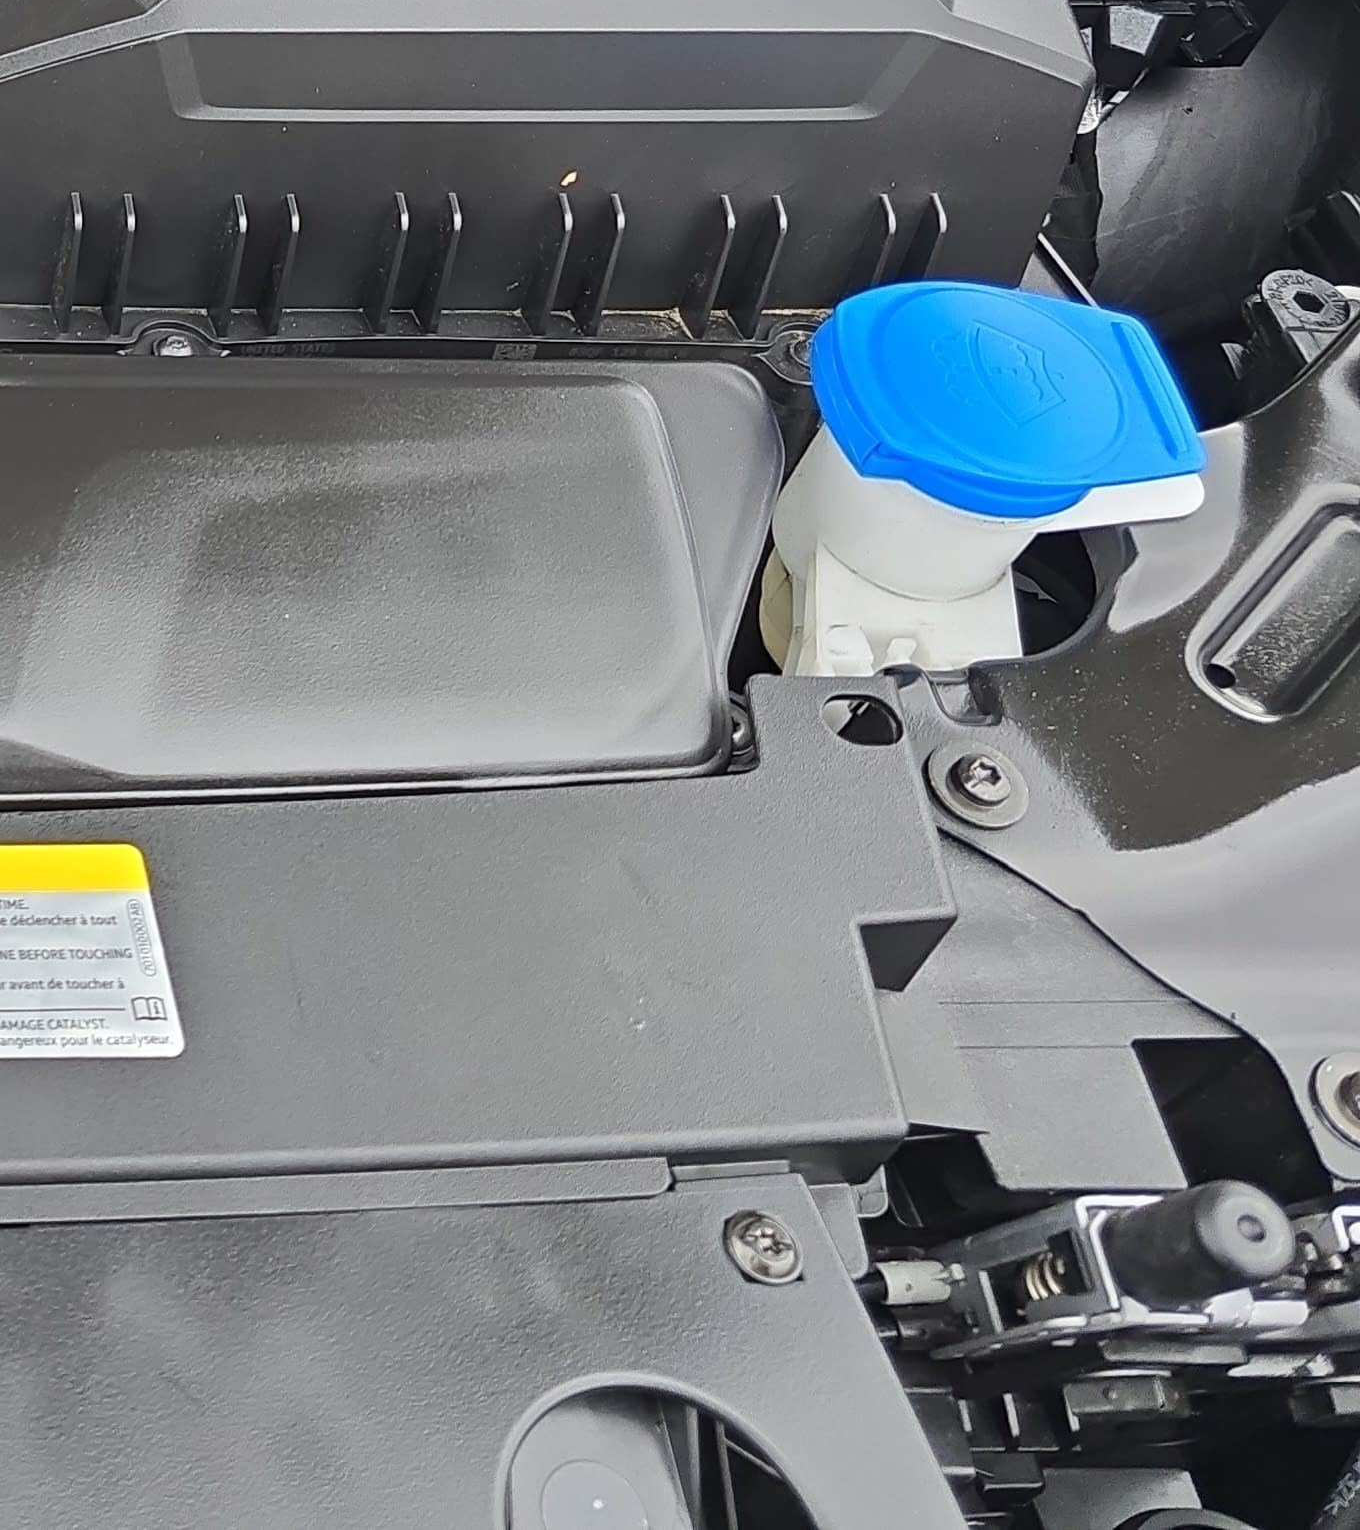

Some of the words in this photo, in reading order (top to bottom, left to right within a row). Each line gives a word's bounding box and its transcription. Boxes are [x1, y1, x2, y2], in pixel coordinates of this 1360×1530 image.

[10, 914, 77, 926] déclencher
[79, 916, 89, 926] à
[90, 915, 118, 926] tout
[18, 949, 67, 961] BEFORE
[68, 948, 133, 960] TOUCHING
[9, 980, 45, 990] avant
[47, 978, 63, 990] de
[65, 978, 112, 990] toucher
[117, 977, 125, 990] à
[60, 1036, 89, 1048] pour
[91, 1034, 103, 1046] le
